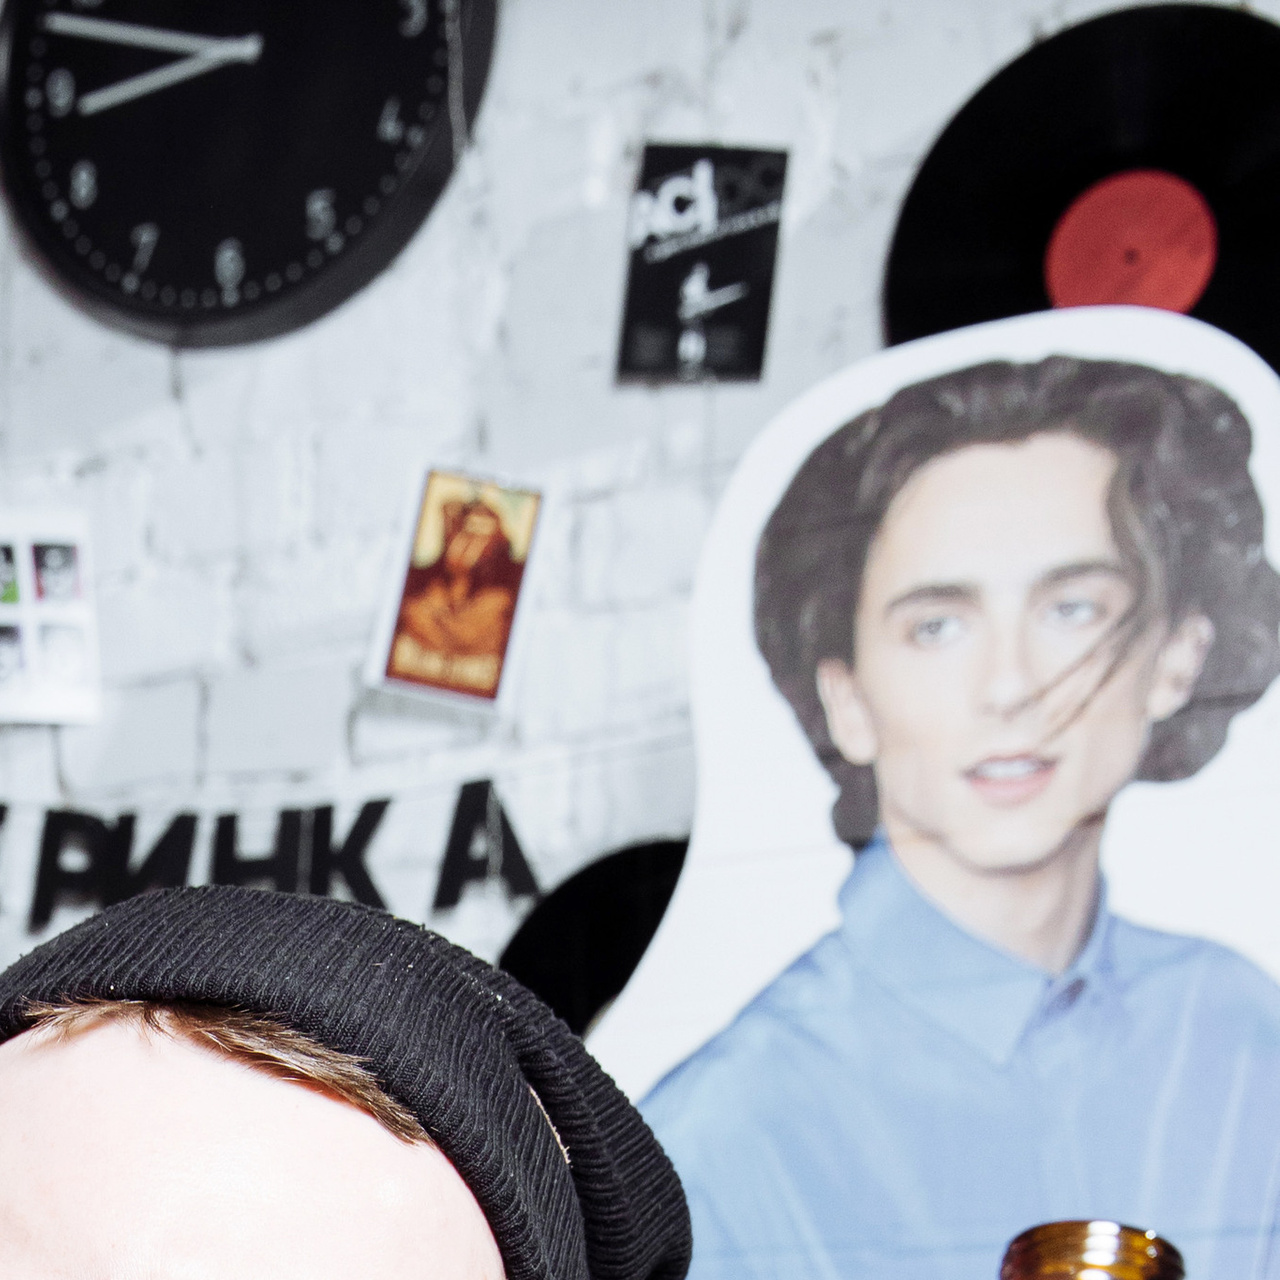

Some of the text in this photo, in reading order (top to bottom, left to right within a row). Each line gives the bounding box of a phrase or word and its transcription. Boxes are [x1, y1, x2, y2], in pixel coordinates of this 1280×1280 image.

[46, 68, 76, 118] 9
[70, 159, 98, 210] 8
[306, 188, 337, 241] 5
[130, 222, 160, 275] 7
[215, 237, 246, 290] 6
